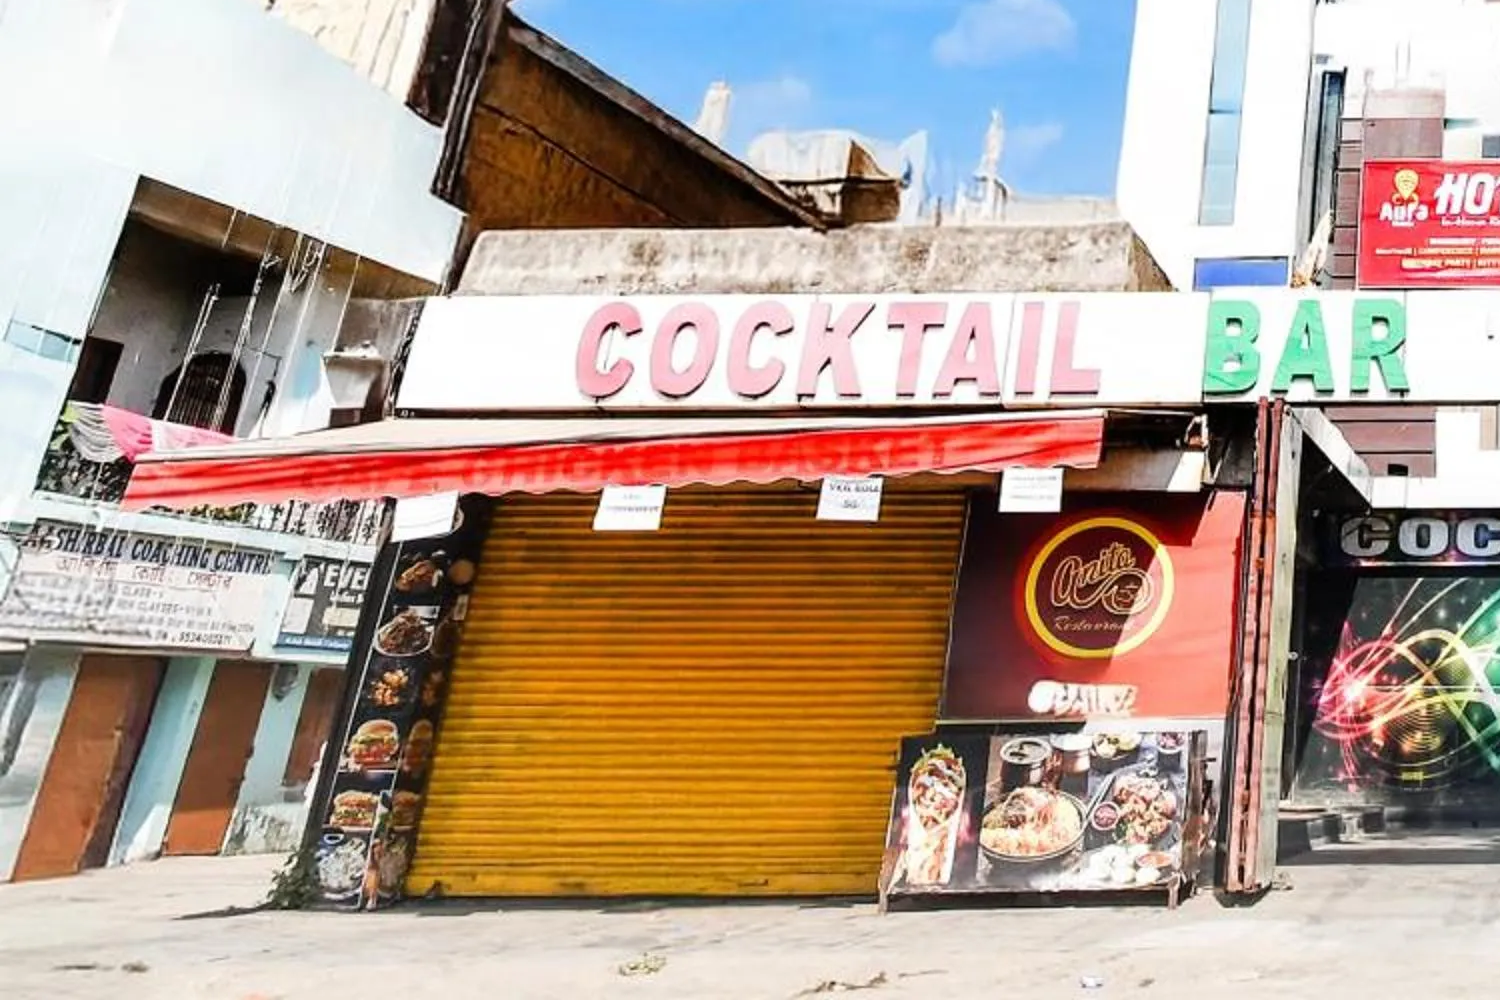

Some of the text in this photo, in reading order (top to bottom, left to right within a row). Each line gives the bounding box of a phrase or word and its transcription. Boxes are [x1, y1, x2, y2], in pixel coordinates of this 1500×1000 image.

[574, 298, 1407, 398] COCKTAIL BAR
[131, 538, 213, 569] COACHING
